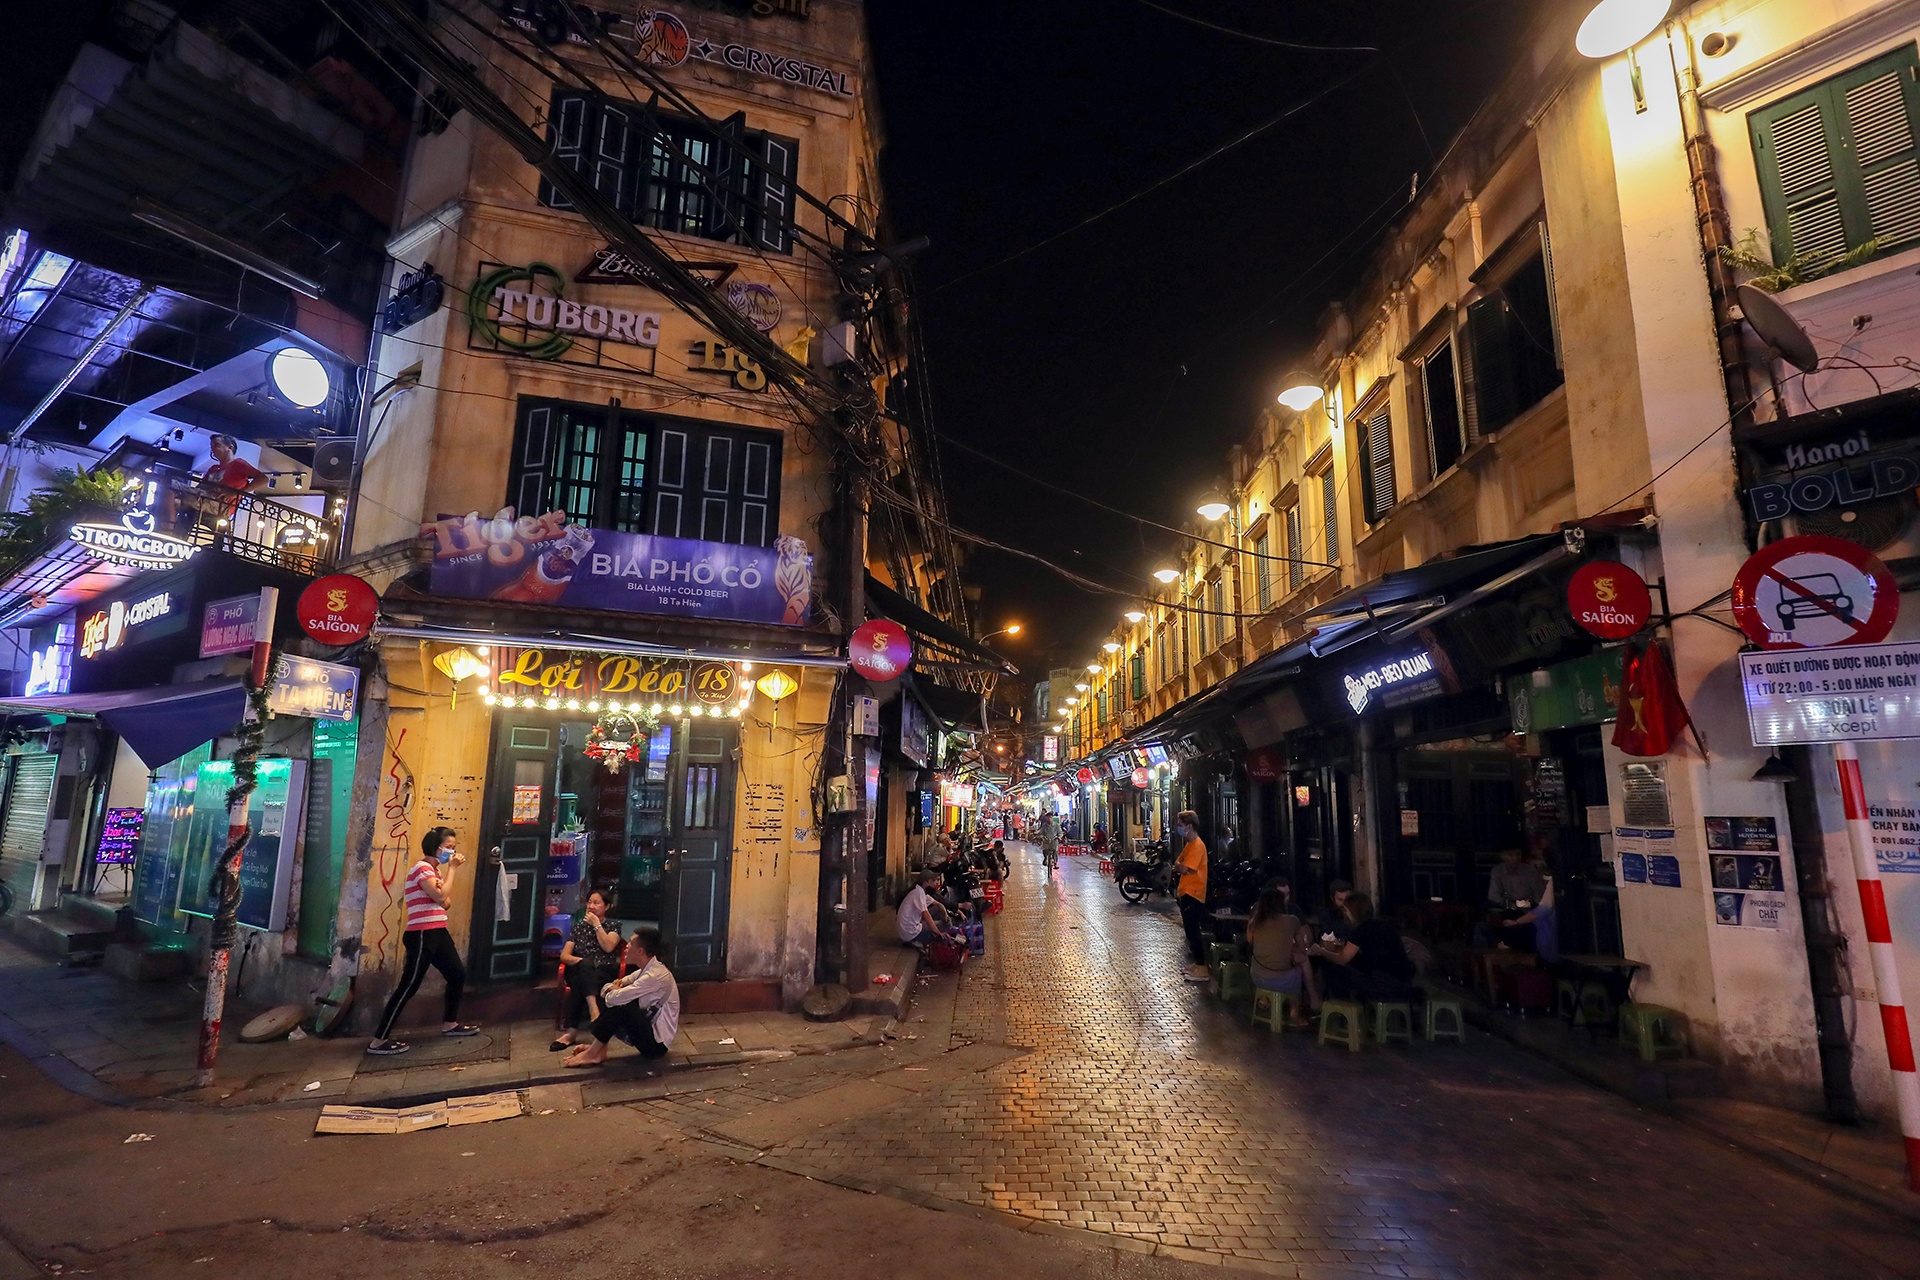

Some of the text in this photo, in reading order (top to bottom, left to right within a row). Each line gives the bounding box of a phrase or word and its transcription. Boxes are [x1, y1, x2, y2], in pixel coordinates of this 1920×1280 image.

[723, 44, 854, 97] CRYSTAL
[495, 287, 660, 348] TUBORG
[694, 339, 766, 390] Tig
[1786, 430, 1871, 470] Hanoi
[1750, 456, 1920, 523] BOLD
[71, 527, 195, 560] STRONGBOW
[420, 505, 567, 567] Tiger
[531, 539, 557, 552] 1932
[87, 549, 173, 570] APPLE CIDERS
[450, 552, 483, 565] SINCE
[592, 554, 762, 589] BIA PHỐ CỔ
[627, 582, 643, 591] BIA
[645, 584, 671, 594] LẠNH
[678, 587, 703, 597] COLD
[705, 589, 729, 599] BEER
[659, 596, 669, 605] 18
[671, 597, 681, 606] Tạ
[1599, 605, 1616, 613] BIA
[223, 603, 244, 620] PHỐ
[327, 614, 343, 622] BIA
[1582, 612, 1635, 625] SAIGON
[309, 619, 360, 633] SAIGON
[1527, 620, 1573, 647] TUBO
[499, 648, 686, 696] Lợi Béo
[858, 656, 896, 672] SAIGON
[1750, 651, 1920, 675] XE QUÉT ĐƯỜNG ĐƯỢC HOẠT ĐỘN
[698, 668, 731, 691] 18
[1855, 675, 1884, 690] HÀNG
[1887, 672, 1917, 687] NGÀY
[279, 684, 346, 713] TẠ HIỆN
[1820, 719, 1877, 735] Except
[1886, 807, 1915, 818] NHÂN
[1872, 821, 1898, 832] CHẠY
